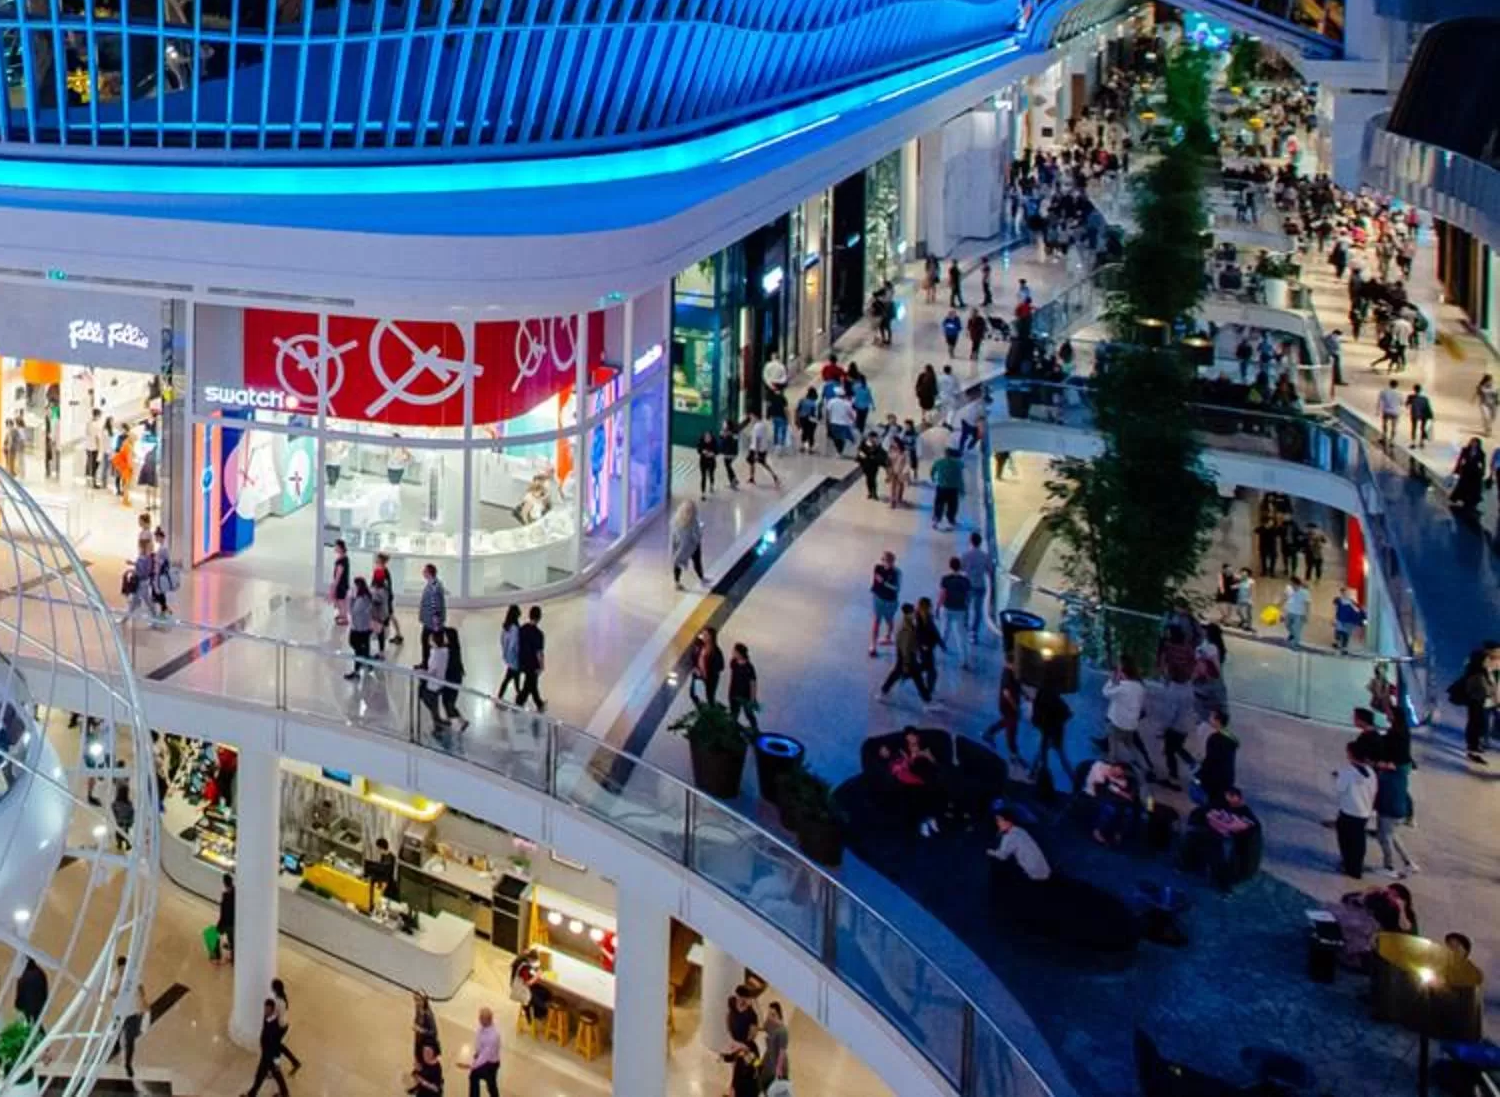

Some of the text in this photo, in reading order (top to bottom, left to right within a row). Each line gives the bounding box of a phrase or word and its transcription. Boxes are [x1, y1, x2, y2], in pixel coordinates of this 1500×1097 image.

[68, 319, 149, 350] Folli Follie
[204, 386, 285, 409] swatch
